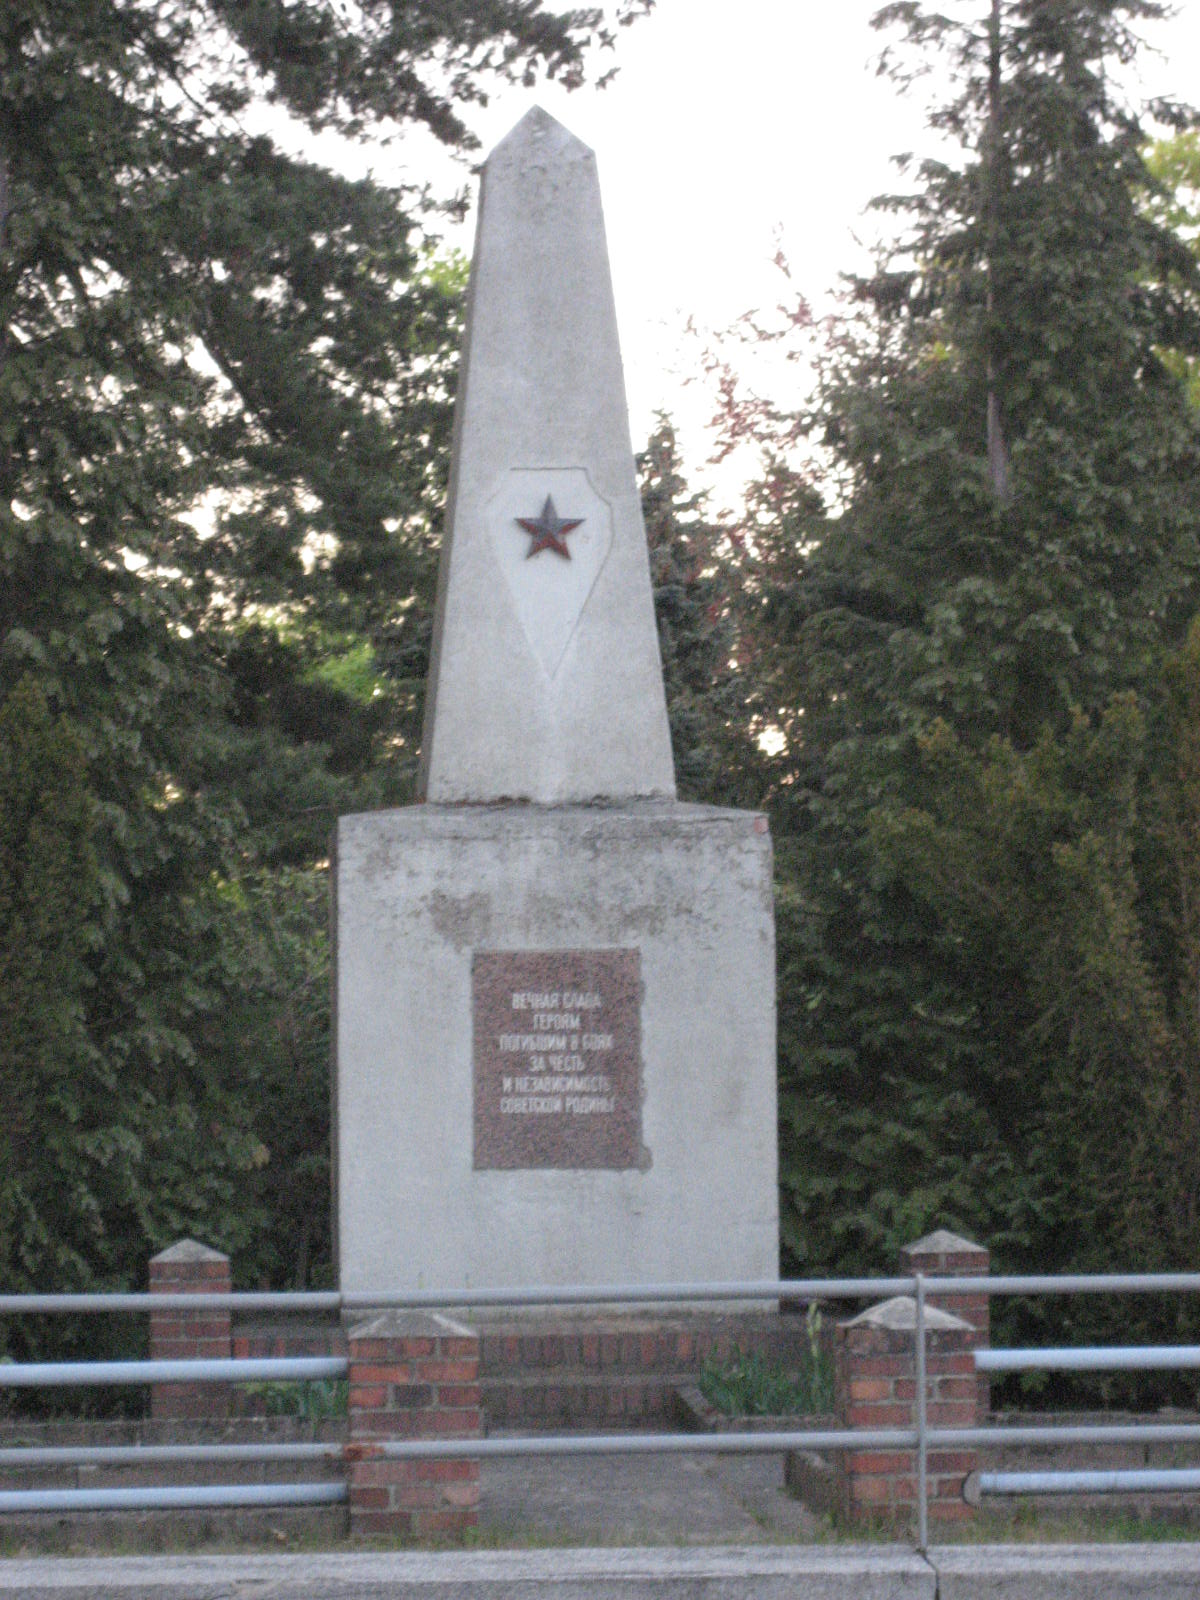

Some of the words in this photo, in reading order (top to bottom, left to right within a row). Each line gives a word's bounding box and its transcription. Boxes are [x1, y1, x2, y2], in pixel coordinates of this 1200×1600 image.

[533, 1014, 581, 1030] ГЕРОЯМ
[529, 1055, 546, 1072] ЗА
[549, 1055, 586, 1071] ЧЕСТЬ
